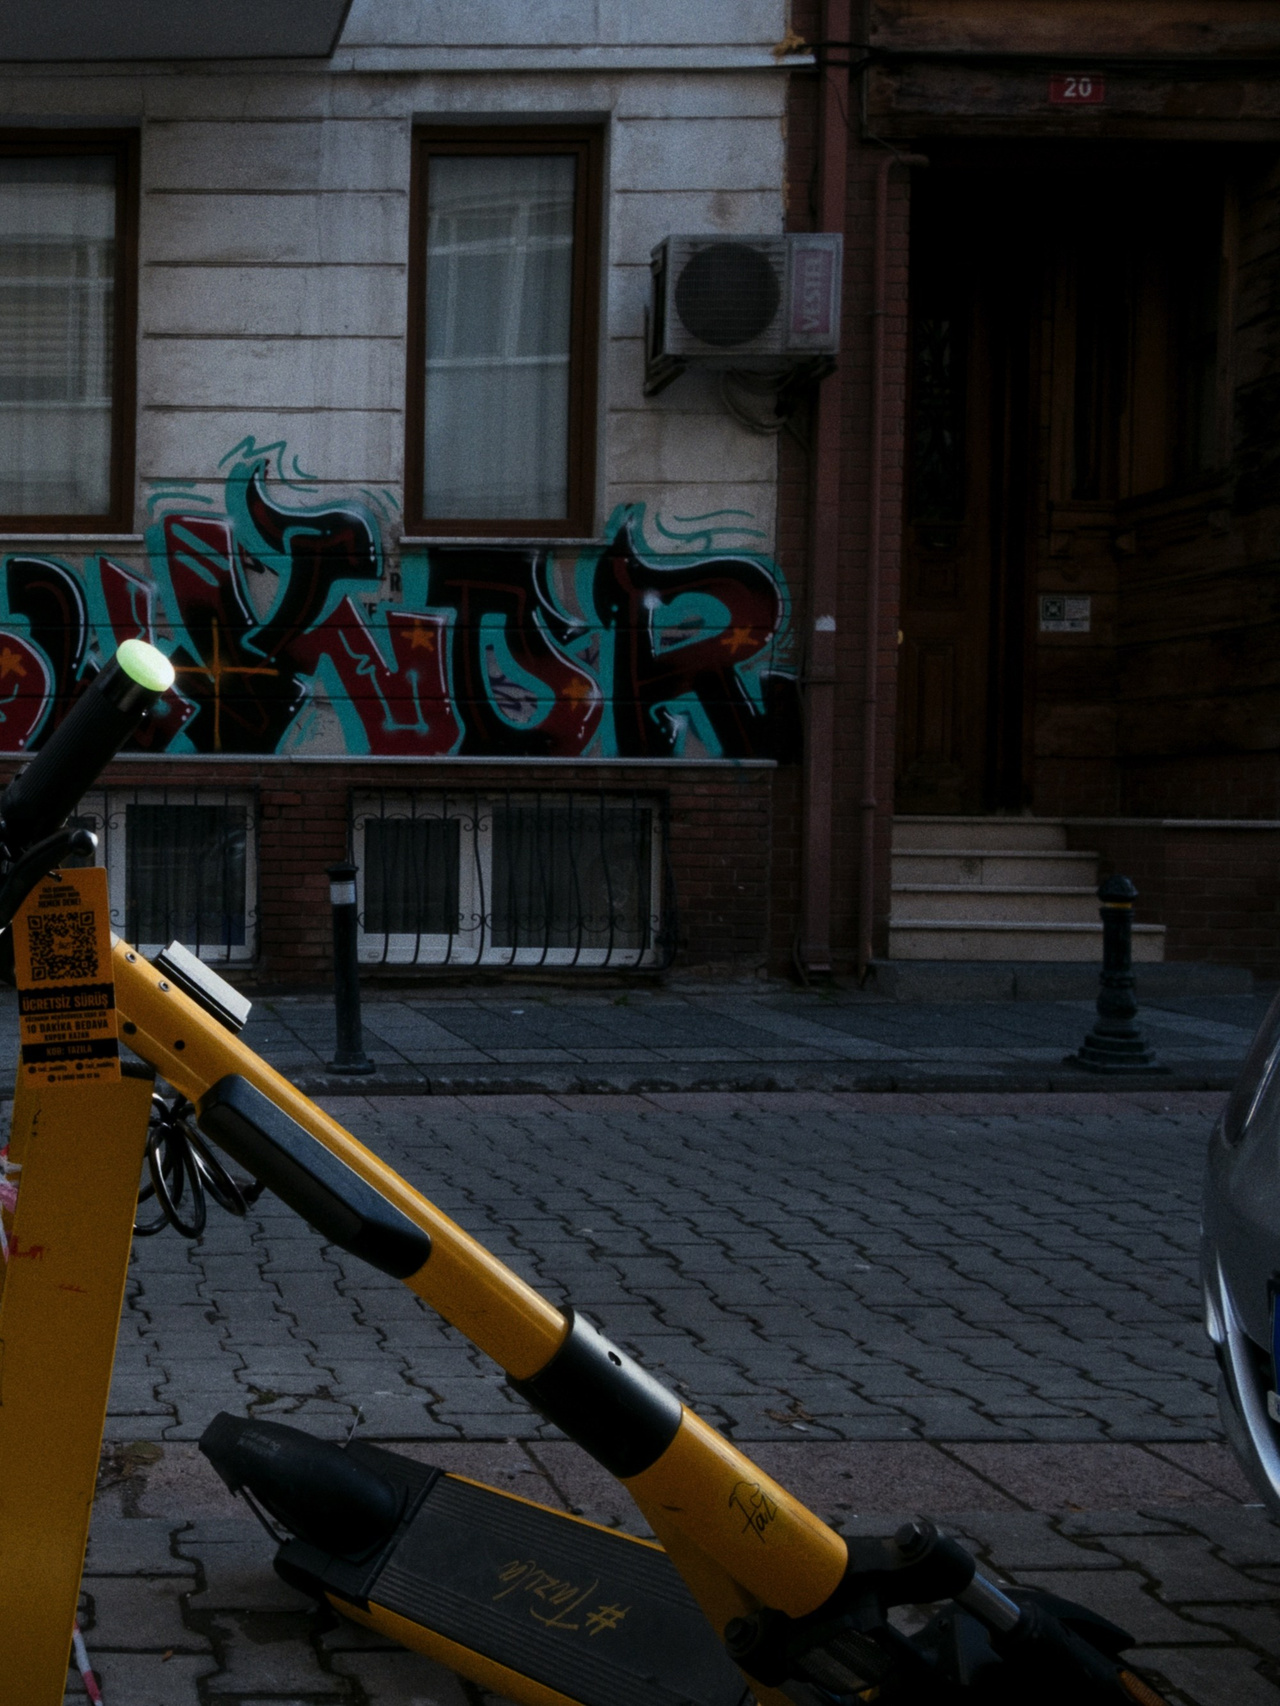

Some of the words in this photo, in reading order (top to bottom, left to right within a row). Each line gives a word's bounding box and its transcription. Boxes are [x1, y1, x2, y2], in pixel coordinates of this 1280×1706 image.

[1063, 77, 1093, 98] 20
[21, 994, 72, 1012] ÜCRETSİZ
[73, 991, 110, 1009] SÜRÜŞ
[27, 1024, 37, 1034] 10
[40, 1020, 72, 1033] DAKİKA
[75, 1018, 109, 1030] BEDAVA
